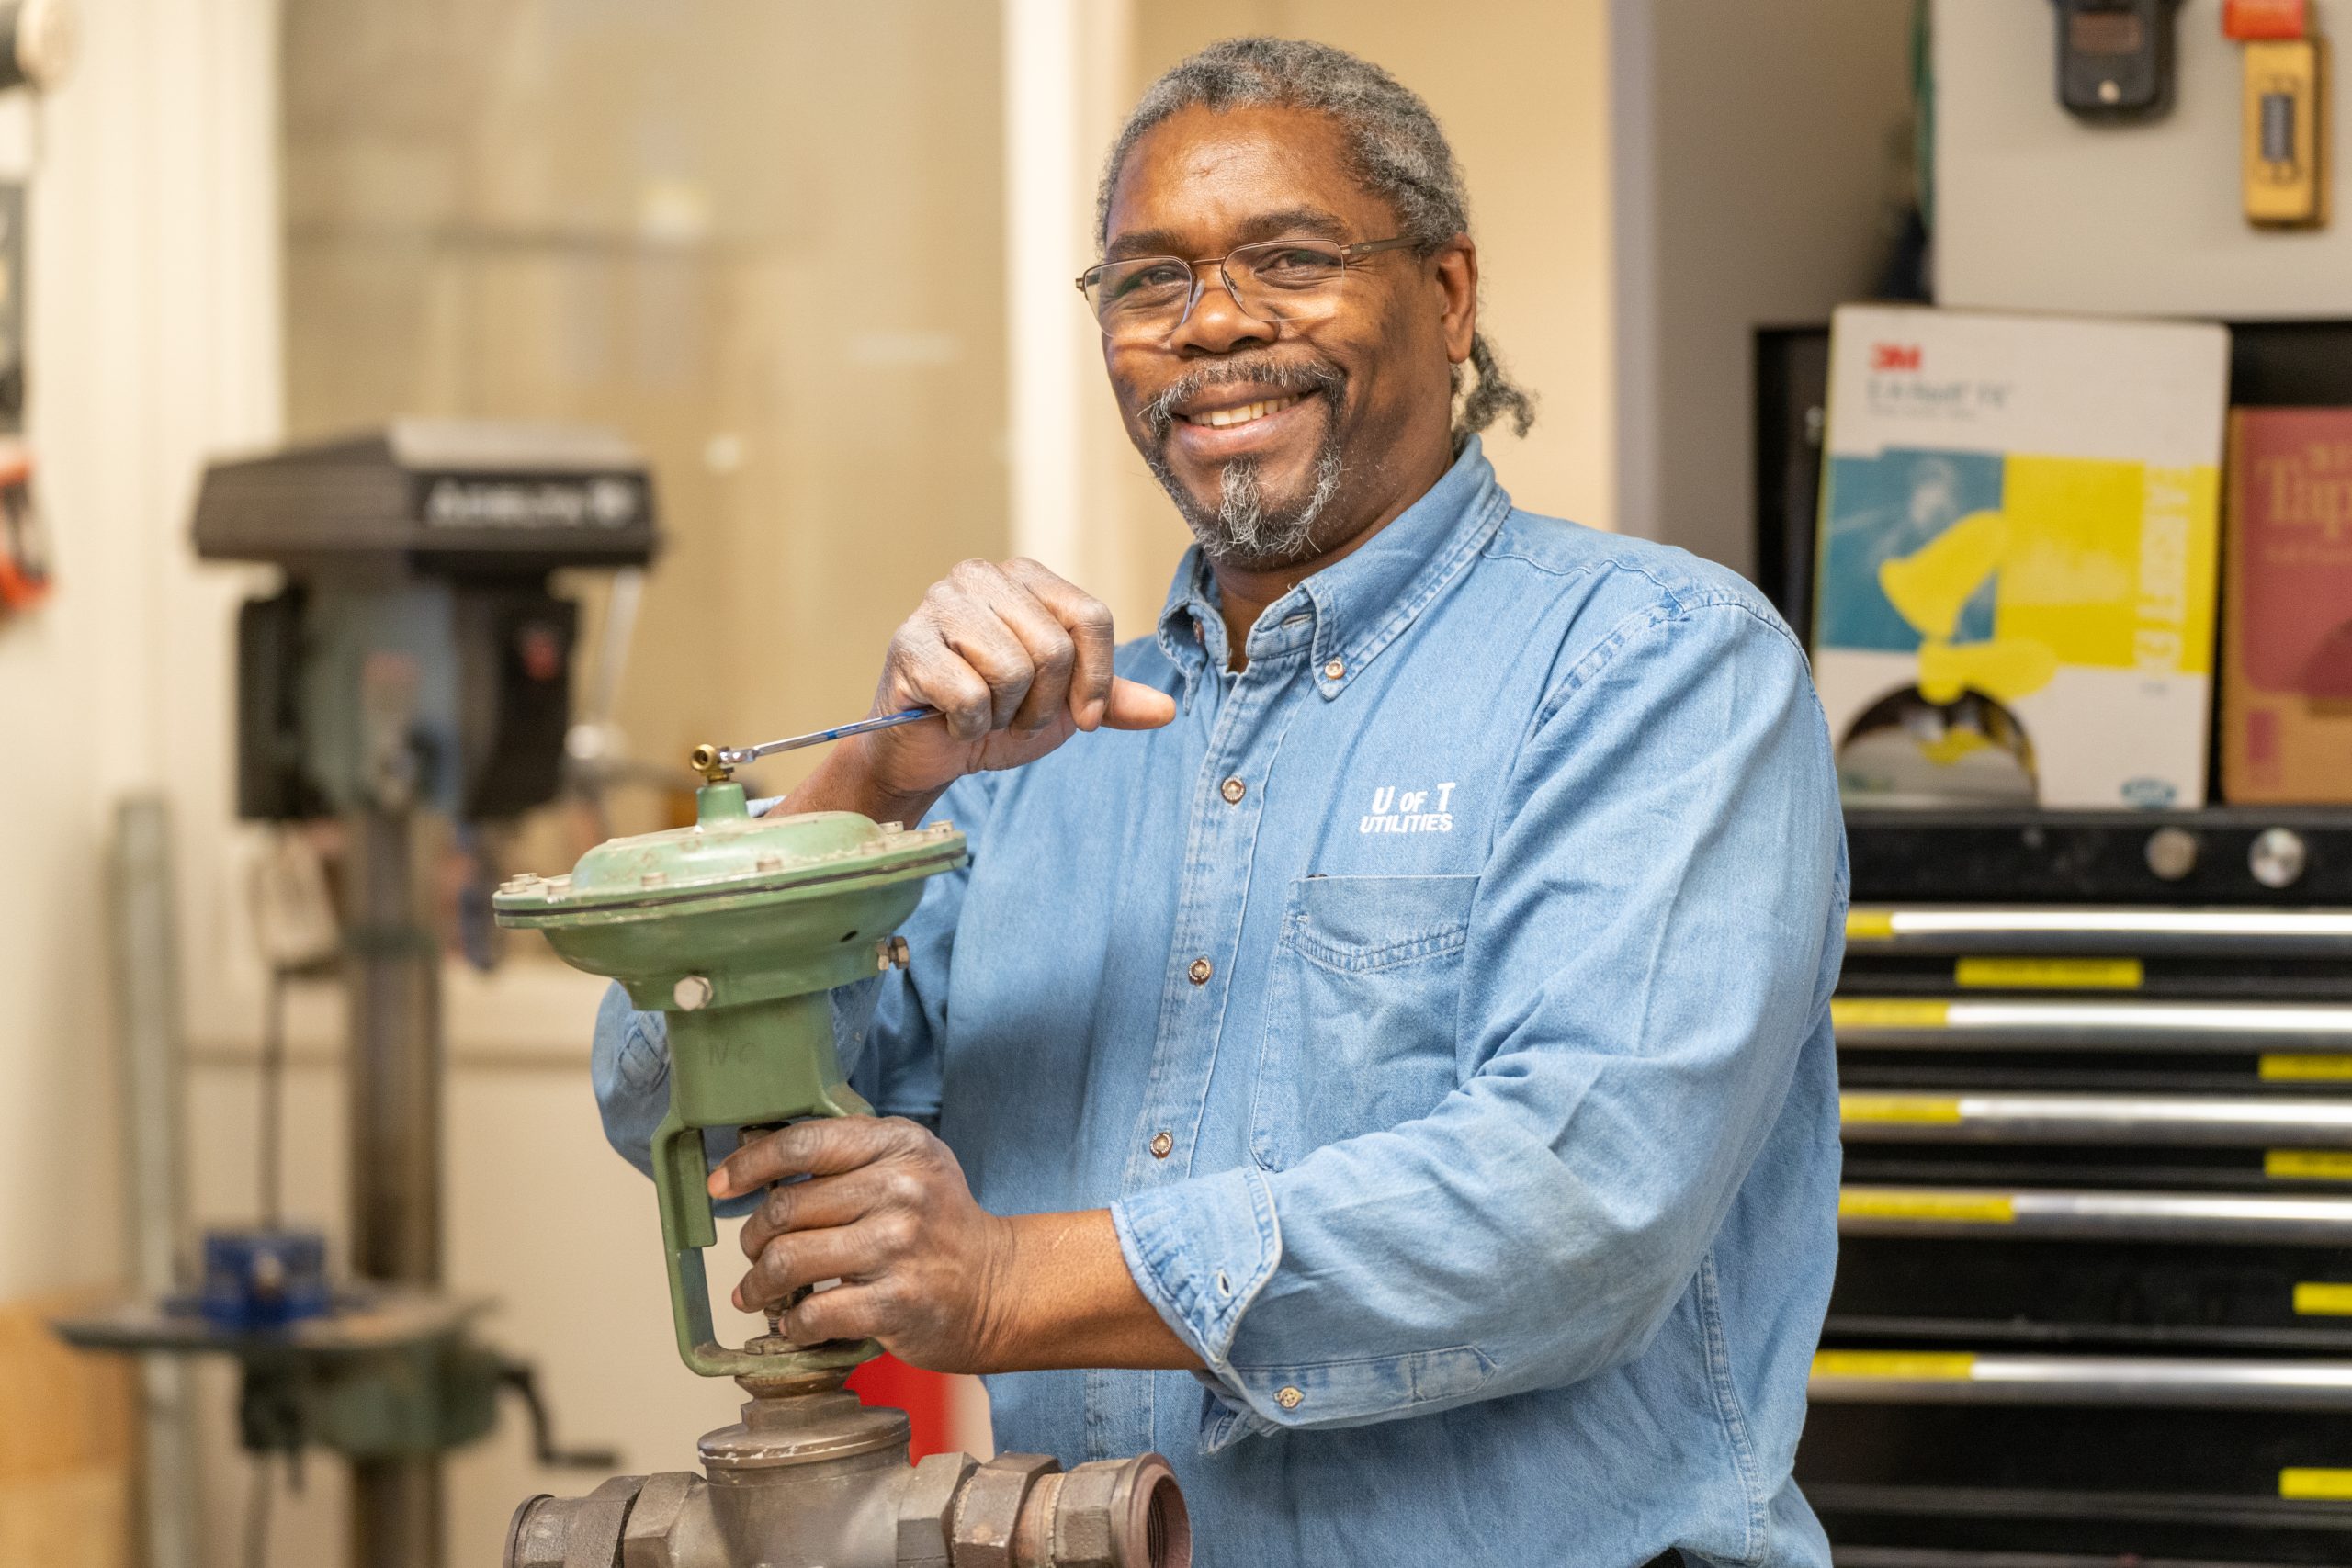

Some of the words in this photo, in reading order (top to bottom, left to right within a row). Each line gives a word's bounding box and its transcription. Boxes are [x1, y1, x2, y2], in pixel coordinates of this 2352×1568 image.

[1870, 343, 1924, 371] 3M
[1372, 785, 1396, 815] U
[1399, 790, 1428, 813] OF
[1437, 782, 1456, 812] T
[1359, 813, 1453, 834] UTILITIES
